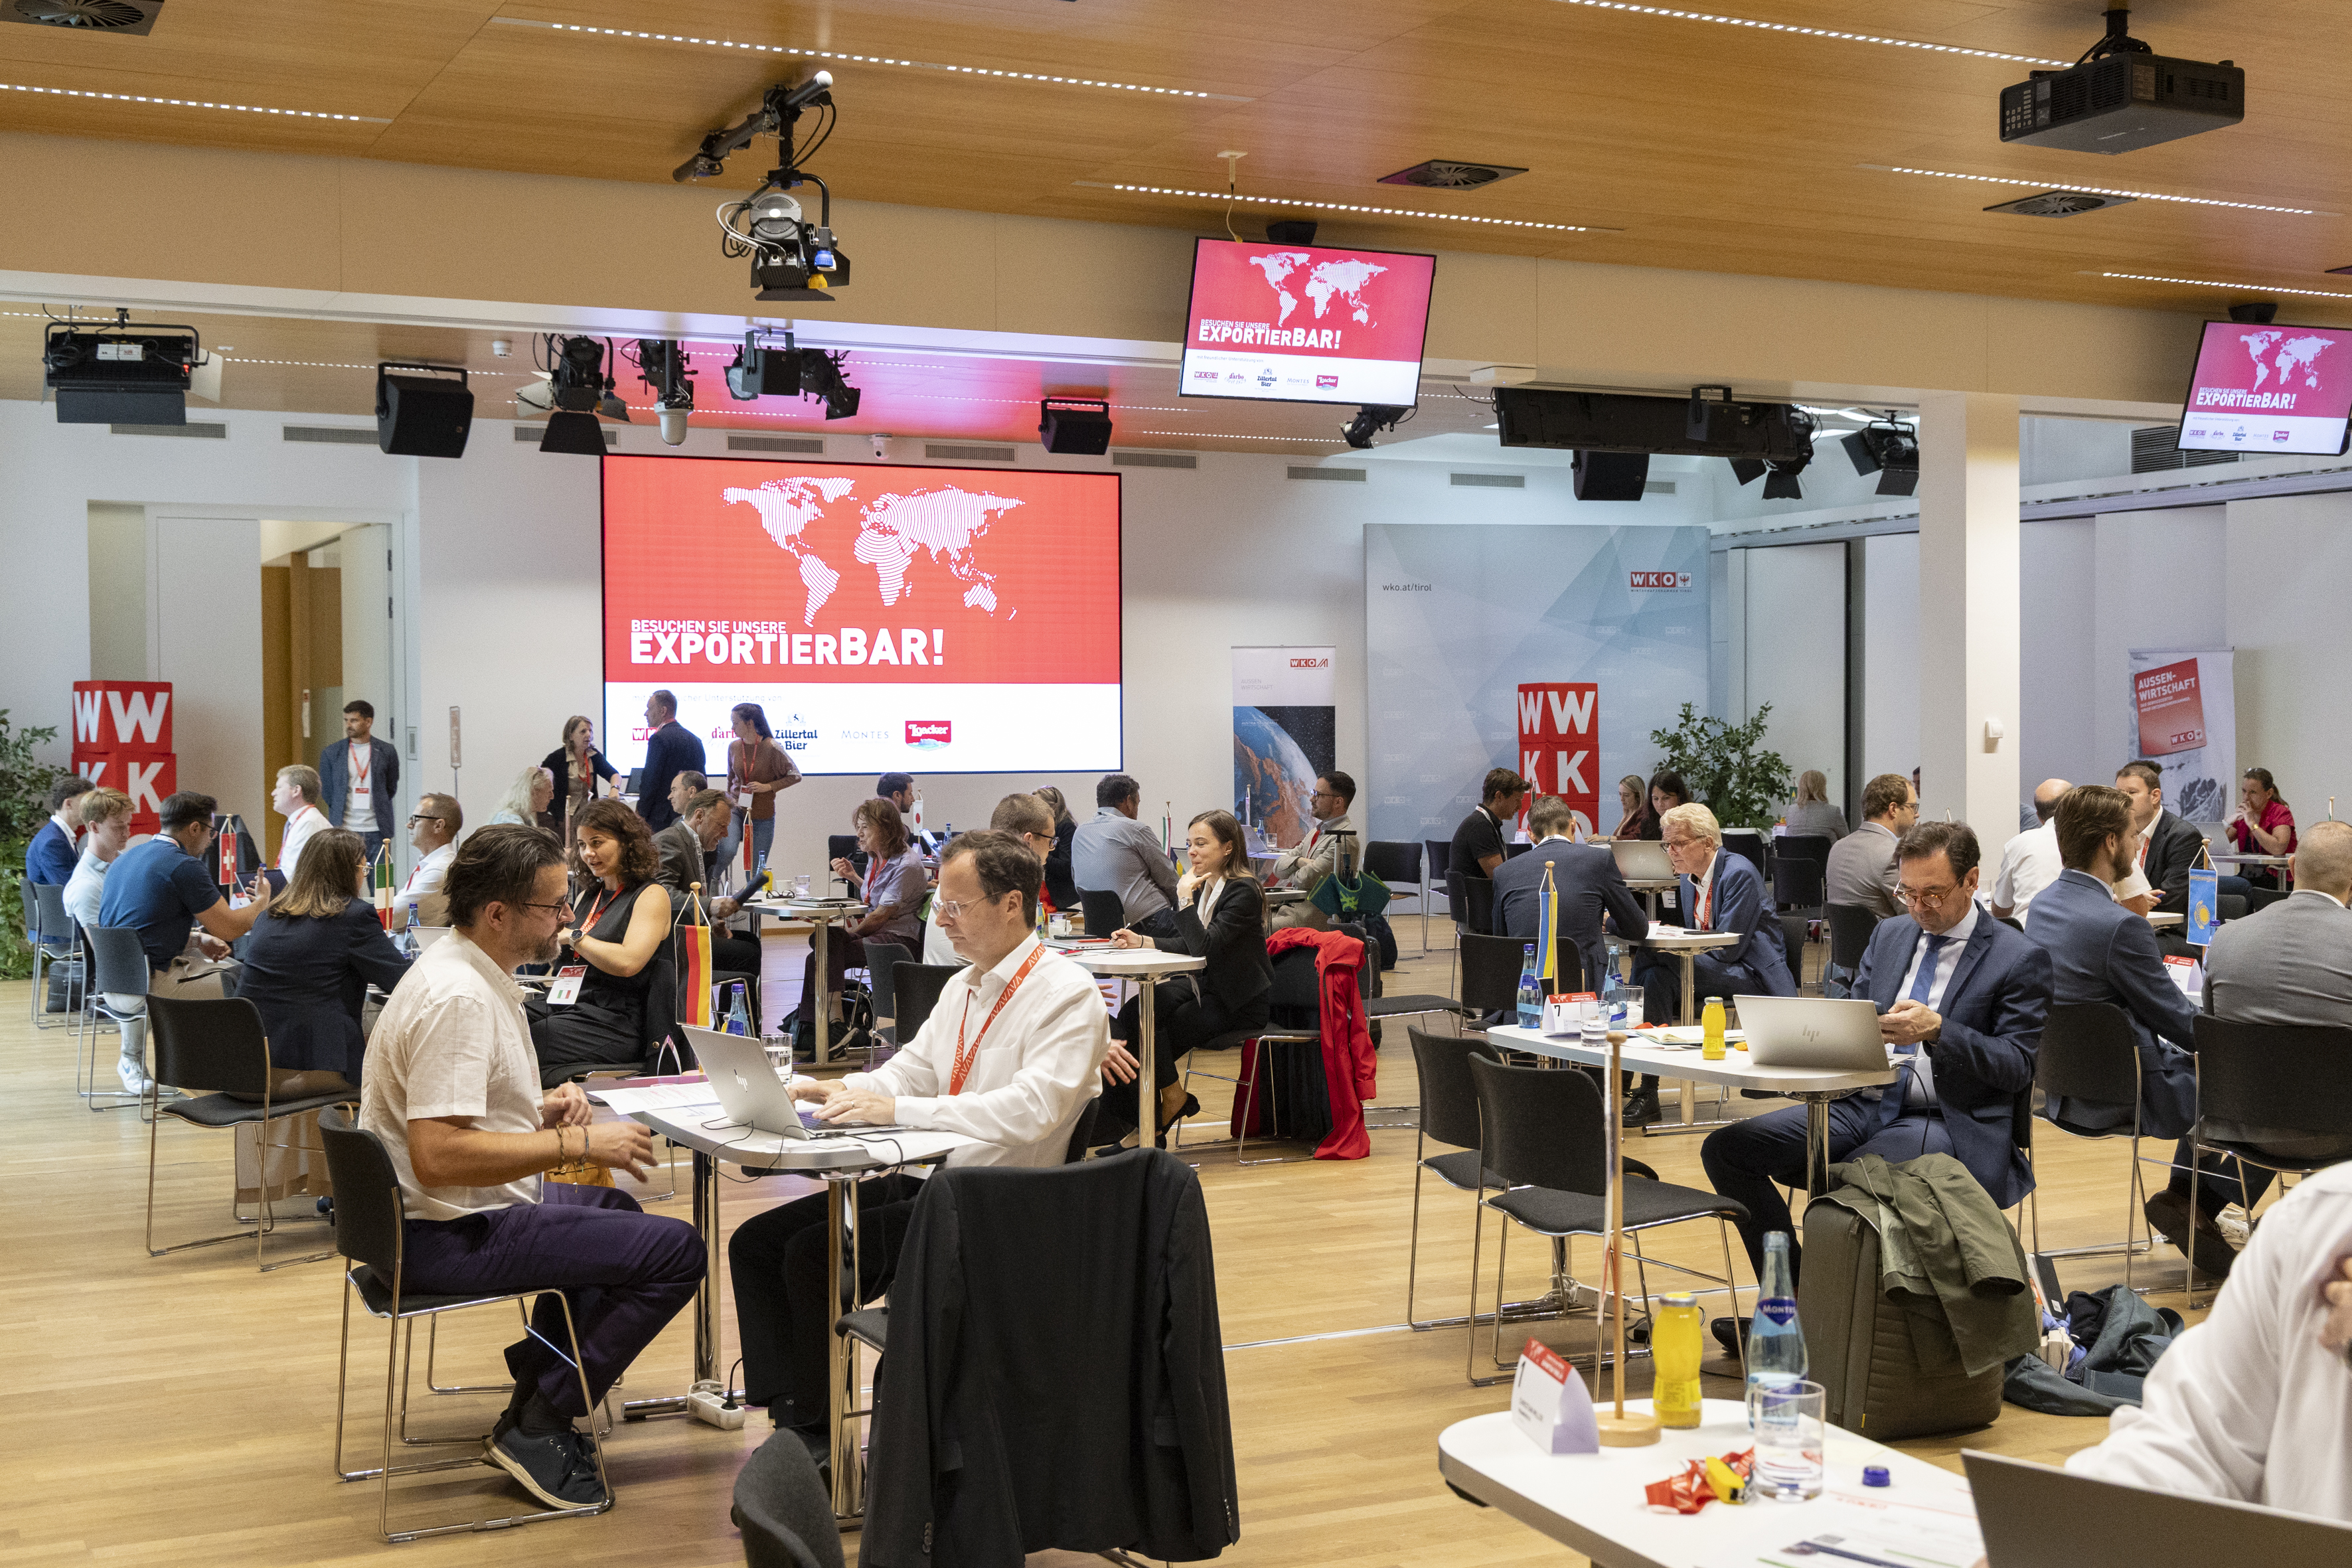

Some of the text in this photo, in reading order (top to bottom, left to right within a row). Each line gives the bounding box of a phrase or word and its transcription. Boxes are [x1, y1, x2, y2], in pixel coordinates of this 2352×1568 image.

[1200, 319, 1233, 328] BESUCHEN
[1245, 321, 1270, 330] UNSERE
[1198, 325, 1342, 349] EXPORTIERBAR!
[2196, 392, 2296, 409] EXPORTIERBAR!
[1382, 583, 1432, 592] wko.at/tirol
[1631, 573, 1676, 587] WKO
[631, 619, 787, 634] BESUCHEN SIE UNSERE
[630, 627, 944, 665] EXPORTIERBAR!
[2138, 671, 2176, 690] AUSSEN-
[2139, 677, 2195, 701] WIRTSCHAFT
[74, 690, 102, 743] W
[106, 690, 170, 744] W
[1518, 691, 1544, 734] W
[1547, 691, 1596, 734] W
[775, 730, 818, 740] Zillertal
[840, 730, 890, 740] MONTES
[908, 724, 949, 738] Loacker
[2171, 732, 2194, 744] WKO
[785, 741, 807, 750] Bier
[1557, 750, 1591, 794] K
[128, 762, 165, 814] K
[1554, 1005, 1560, 1017] 7
